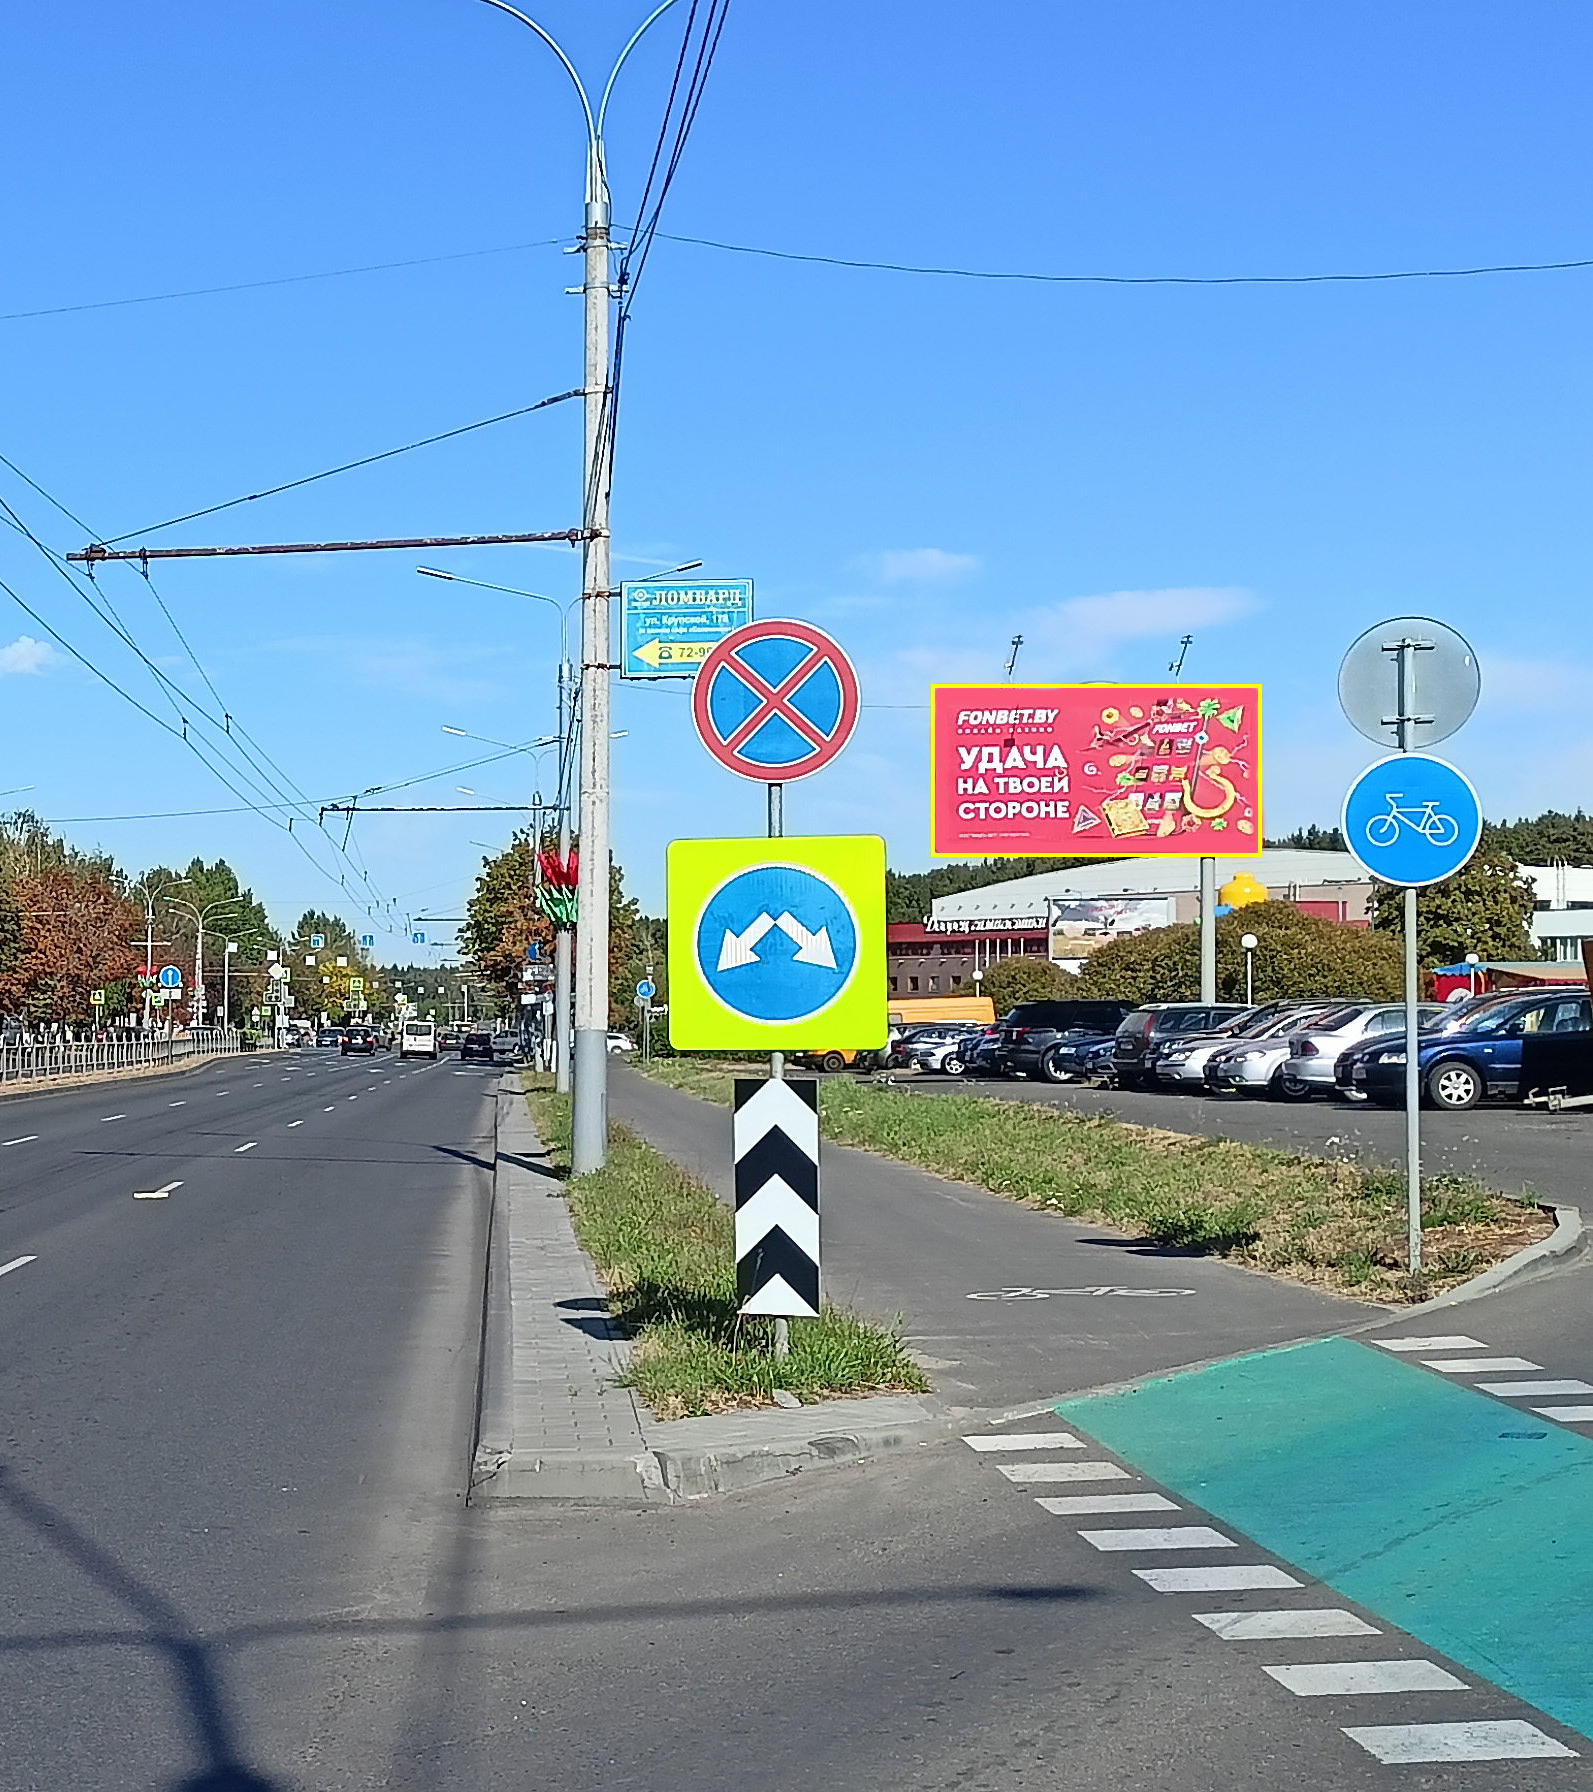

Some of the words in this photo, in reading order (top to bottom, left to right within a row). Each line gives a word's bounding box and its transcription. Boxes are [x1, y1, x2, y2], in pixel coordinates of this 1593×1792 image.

[652, 589, 742, 607] ЛОМБАРД
[957, 709, 1060, 725] FONBET.BY
[957, 744, 1069, 775] УДАЧА
[957, 777, 990, 795] НА
[993, 773, 1070, 794] ТВОЕЙ
[958, 800, 1070, 820] СТОРОНЕ
